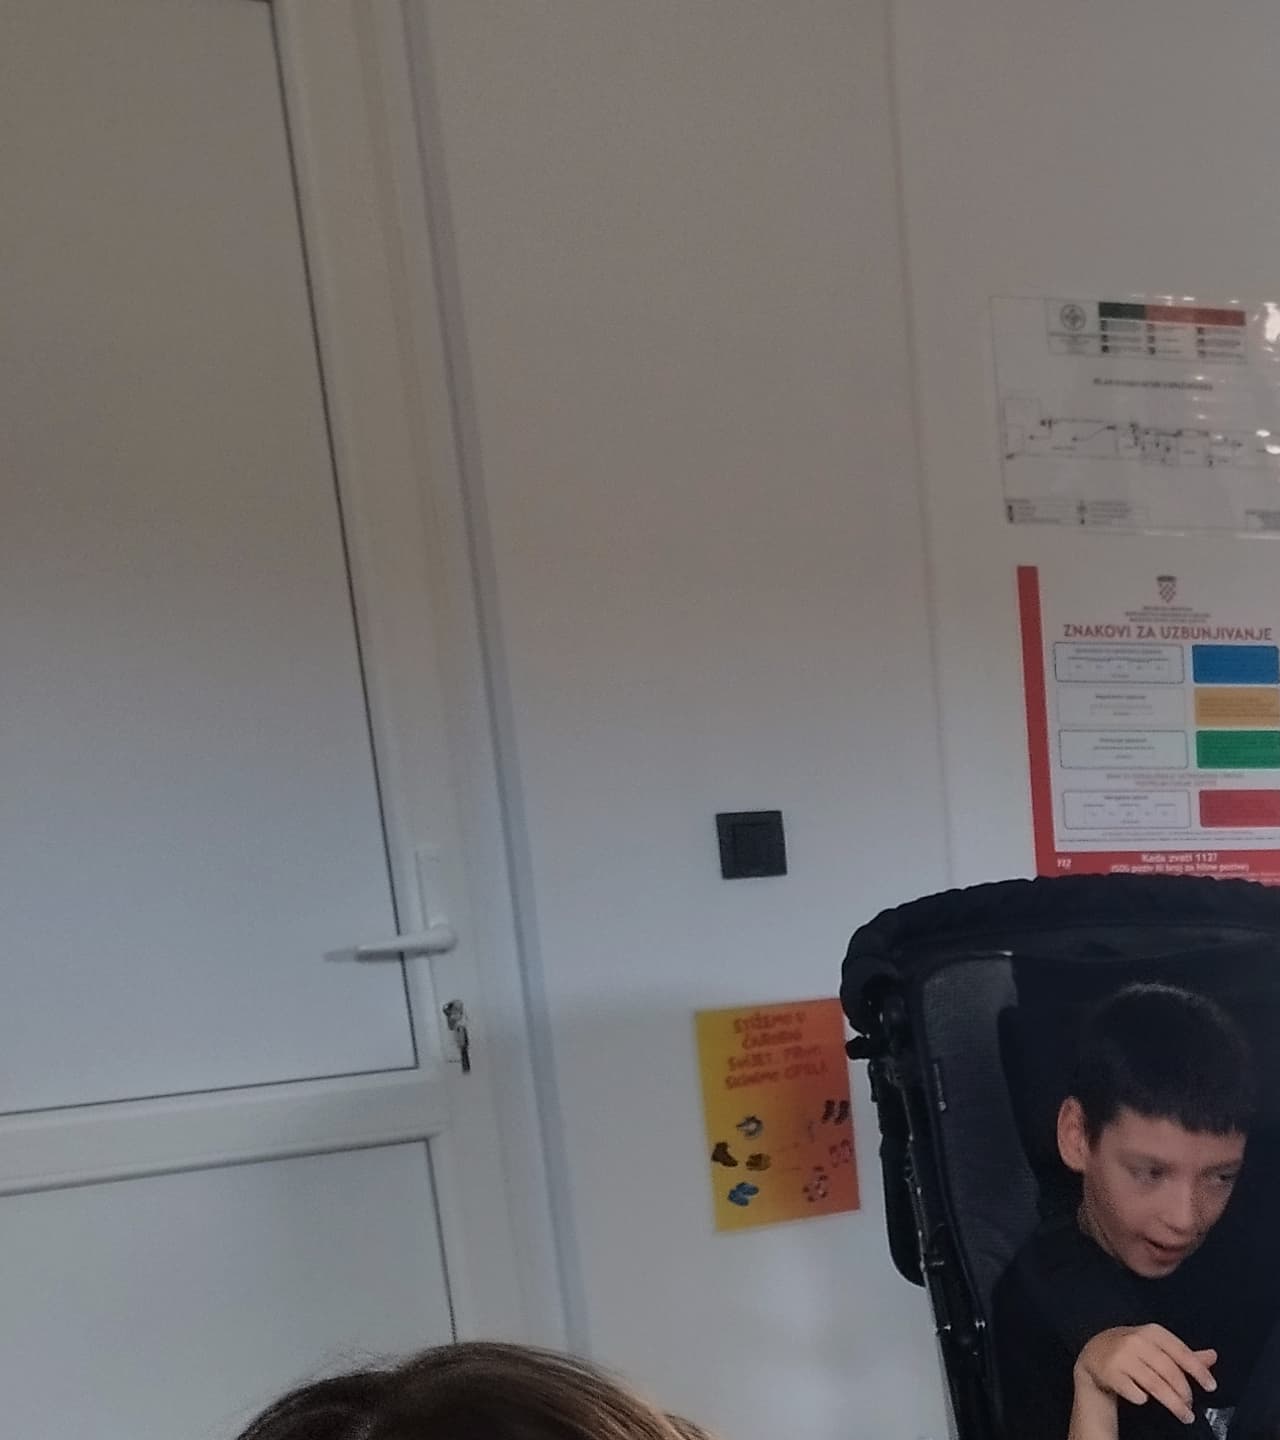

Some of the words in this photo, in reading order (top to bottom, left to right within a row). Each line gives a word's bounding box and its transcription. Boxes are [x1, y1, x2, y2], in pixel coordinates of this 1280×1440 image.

[1063, 623, 1131, 638] ZNAKOVI
[1137, 625, 1155, 638] ZA
[1161, 625, 1273, 640] UZBUNJIVANJE
[1140, 853, 1166, 863] Kada
